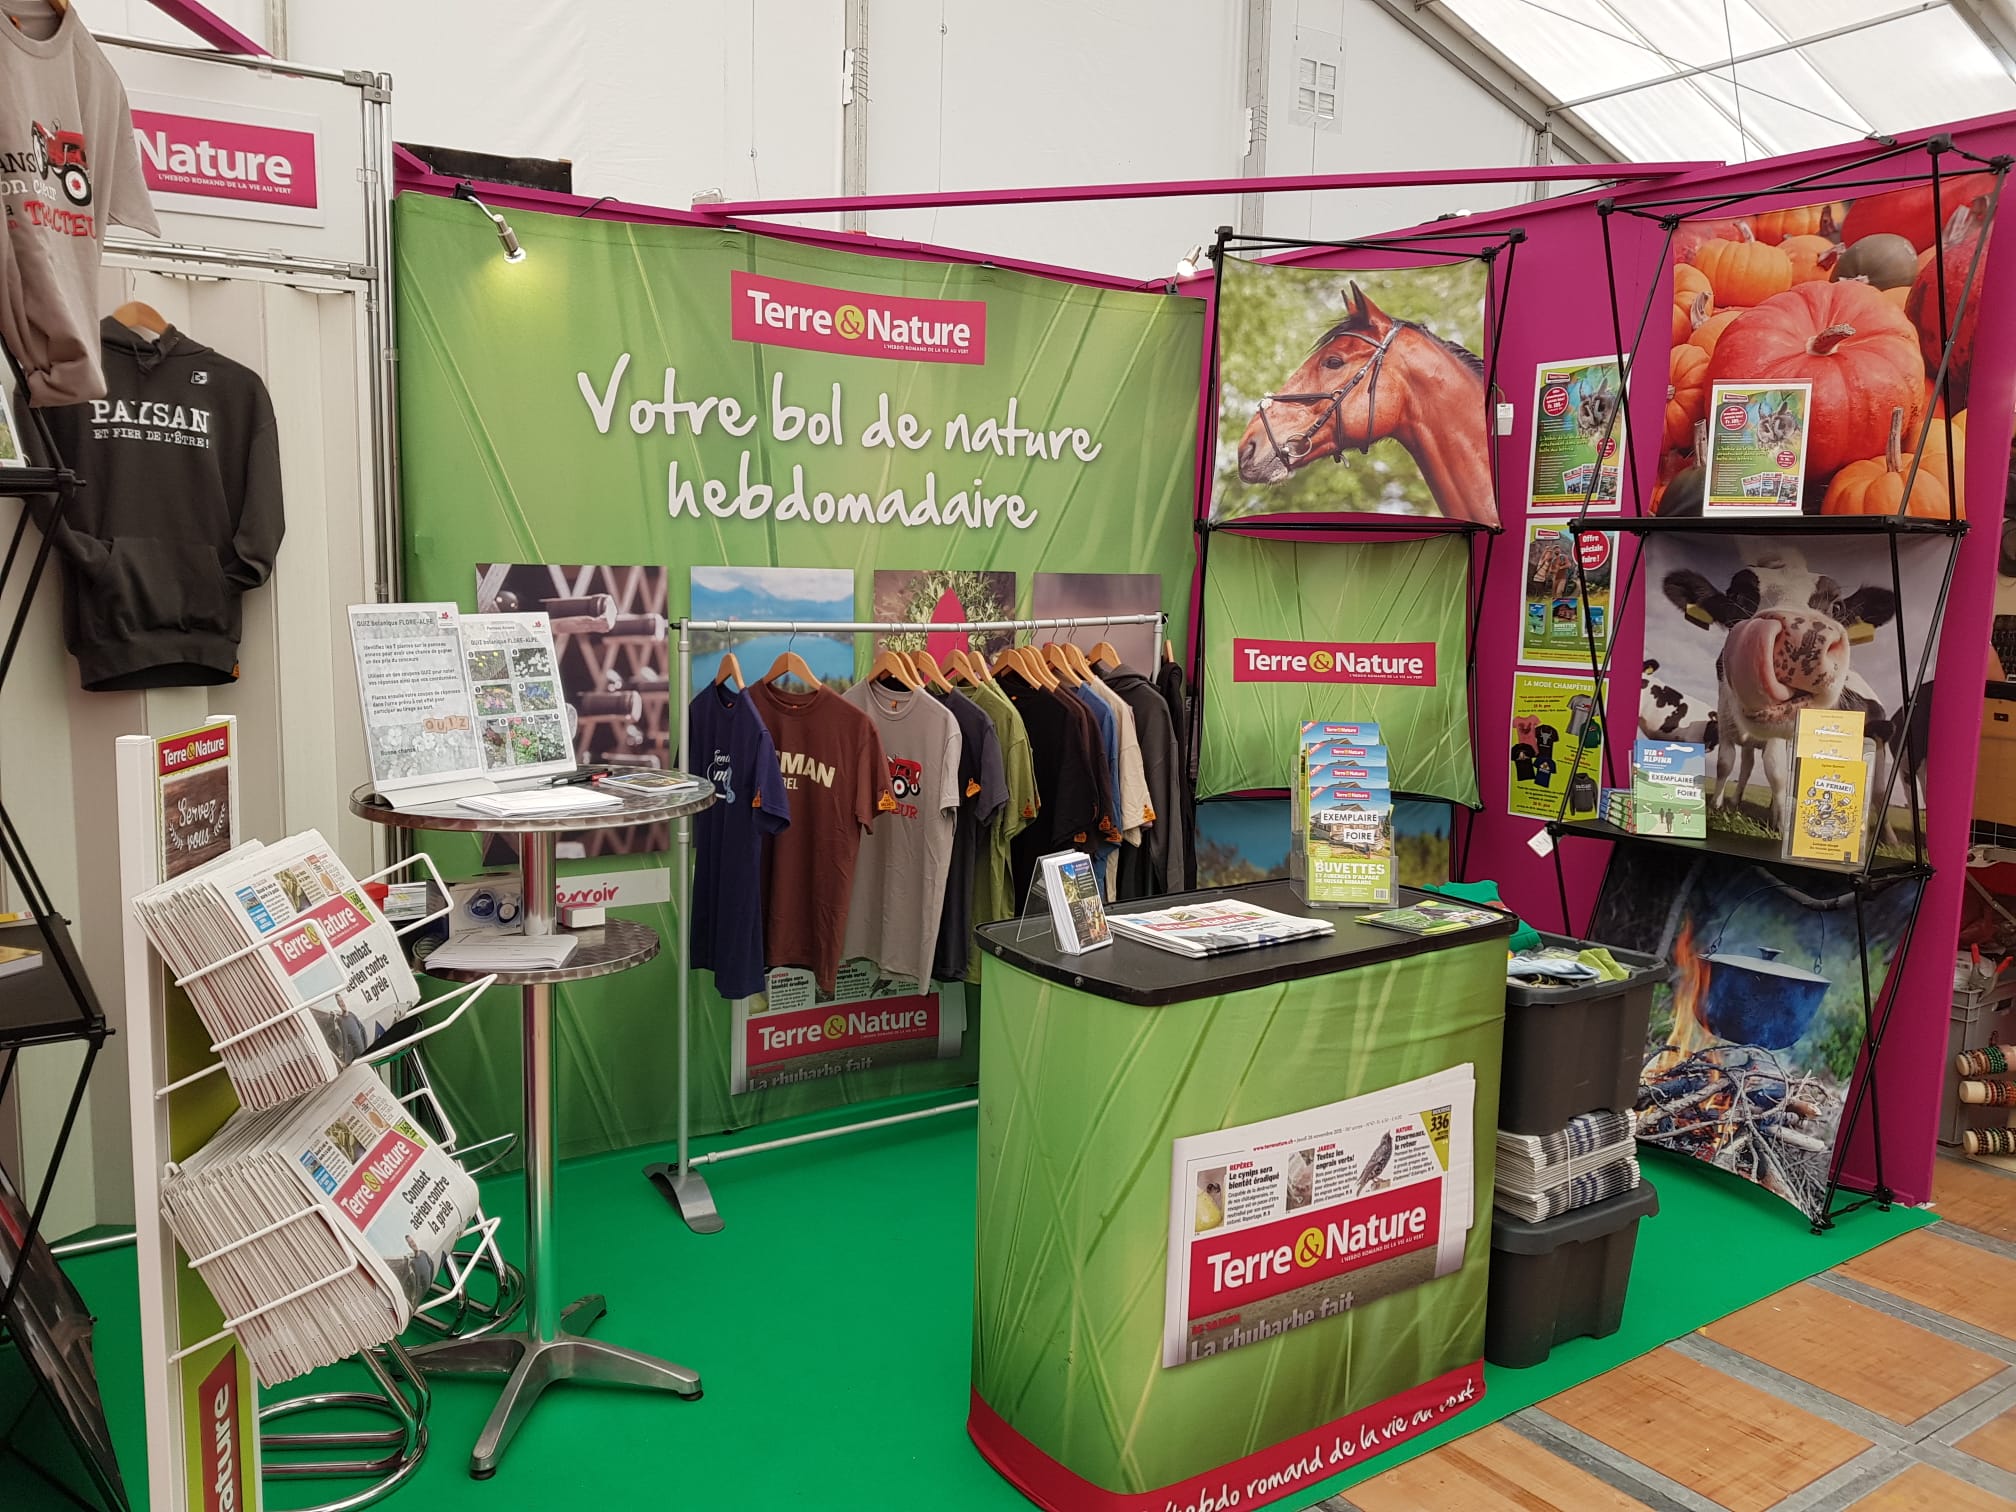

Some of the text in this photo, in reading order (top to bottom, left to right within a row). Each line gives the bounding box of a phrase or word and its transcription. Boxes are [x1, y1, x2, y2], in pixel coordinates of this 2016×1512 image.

[191, 177, 225, 187] ROMAND
[275, 186, 291, 194] VERT
[577, 353, 1102, 461] Votre bol de nature
[89, 399, 210, 434] PAYSAN
[93, 428, 109, 439] ET
[112, 427, 142, 439] FIER
[146, 430, 161, 440] DE
[668, 450, 1038, 529] hebdomadaire
[1651, 774, 1695, 784] EXEMPLAIRE
[1816, 780, 1824, 788] LA
[1323, 813, 1378, 822] EXEMPLAIRE
[1346, 831, 1372, 840] FOIRE
[1315, 861, 1385, 875] BUVETTES
[340, 940, 373, 969] Combat
[365, 953, 389, 977] contre
[361, 975, 389, 1004] la grêle
[1430, 1114, 1450, 1132] 336
[1401, 1140, 1417, 1149] retour
[1229, 1172, 1237, 1181] Le
[1238, 1168, 1259, 1179] cynips
[1230, 1161, 1254, 1171] REPÈRES
[402, 1169, 431, 1204] Combat
[1253, 1172, 1280, 1185] éradiqué
[410, 1176, 450, 1230] aérien contre
[427, 1200, 454, 1235] la grêle
[1246, 1445, 1324, 1498] romand
[1329, 1437, 1356, 1464] de
[1360, 1424, 1380, 1449] la
[1382, 1415, 1408, 1438] vie
[1412, 1409, 1433, 1425] au
